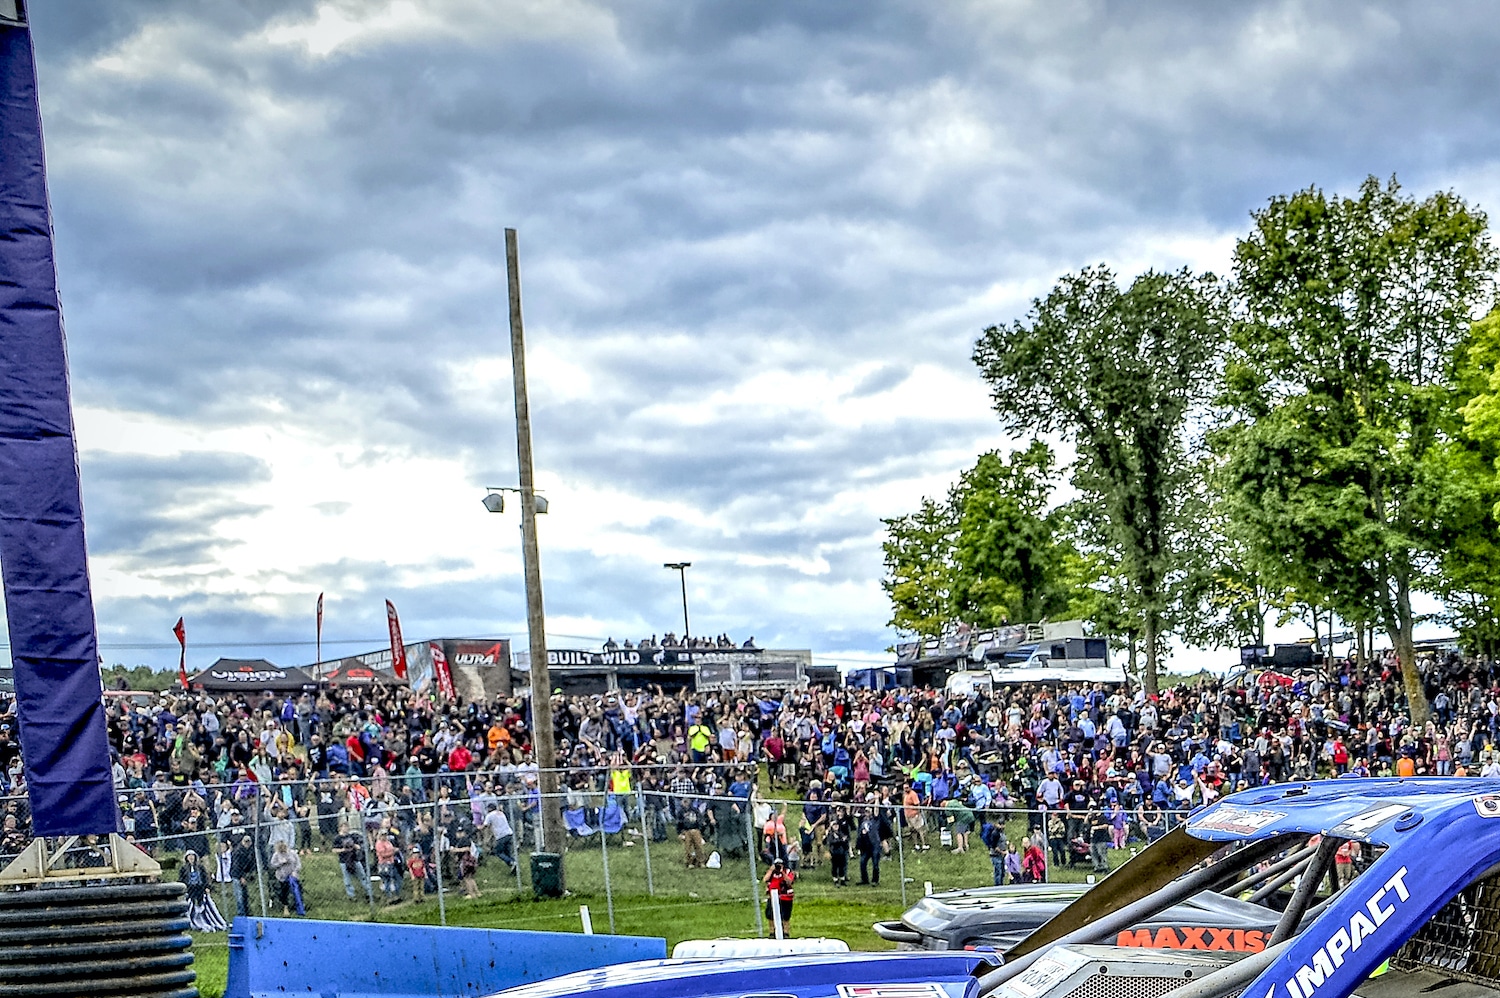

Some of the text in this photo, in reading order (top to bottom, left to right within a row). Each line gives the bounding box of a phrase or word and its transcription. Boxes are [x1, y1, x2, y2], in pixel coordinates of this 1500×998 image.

[547, 651, 640, 664] BUILT WILD
[1116, 926, 1266, 954] MAXXIS
